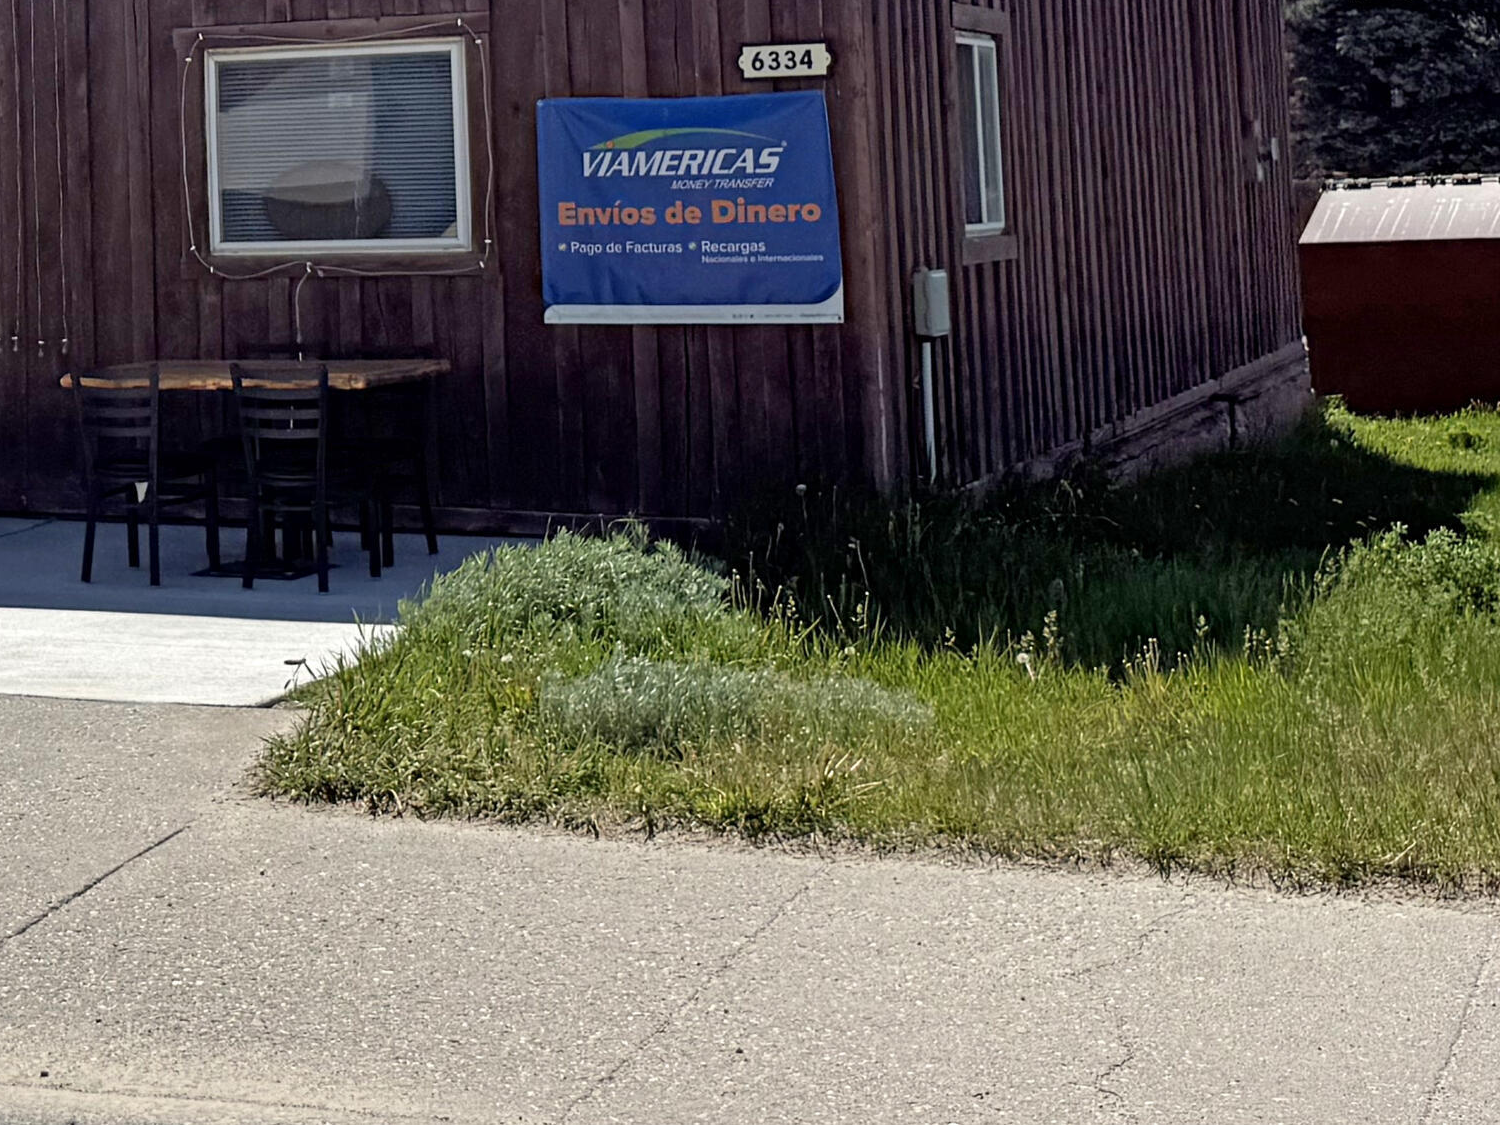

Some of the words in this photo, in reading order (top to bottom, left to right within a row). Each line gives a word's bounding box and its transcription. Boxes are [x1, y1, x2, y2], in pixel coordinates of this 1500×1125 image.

[750, 49, 815, 73] 6334
[582, 147, 785, 178] VIAMERICAS
[670, 178, 712, 190] MONEY
[713, 177, 775, 190] TRANSFER
[557, 199, 657, 226] Envíos
[664, 200, 702, 225] de
[711, 196, 822, 224] Dinero
[570, 241, 603, 256] Pago
[605, 241, 623, 254] de
[625, 240, 683, 254] Facturas
[701, 240, 767, 255] Recargas
